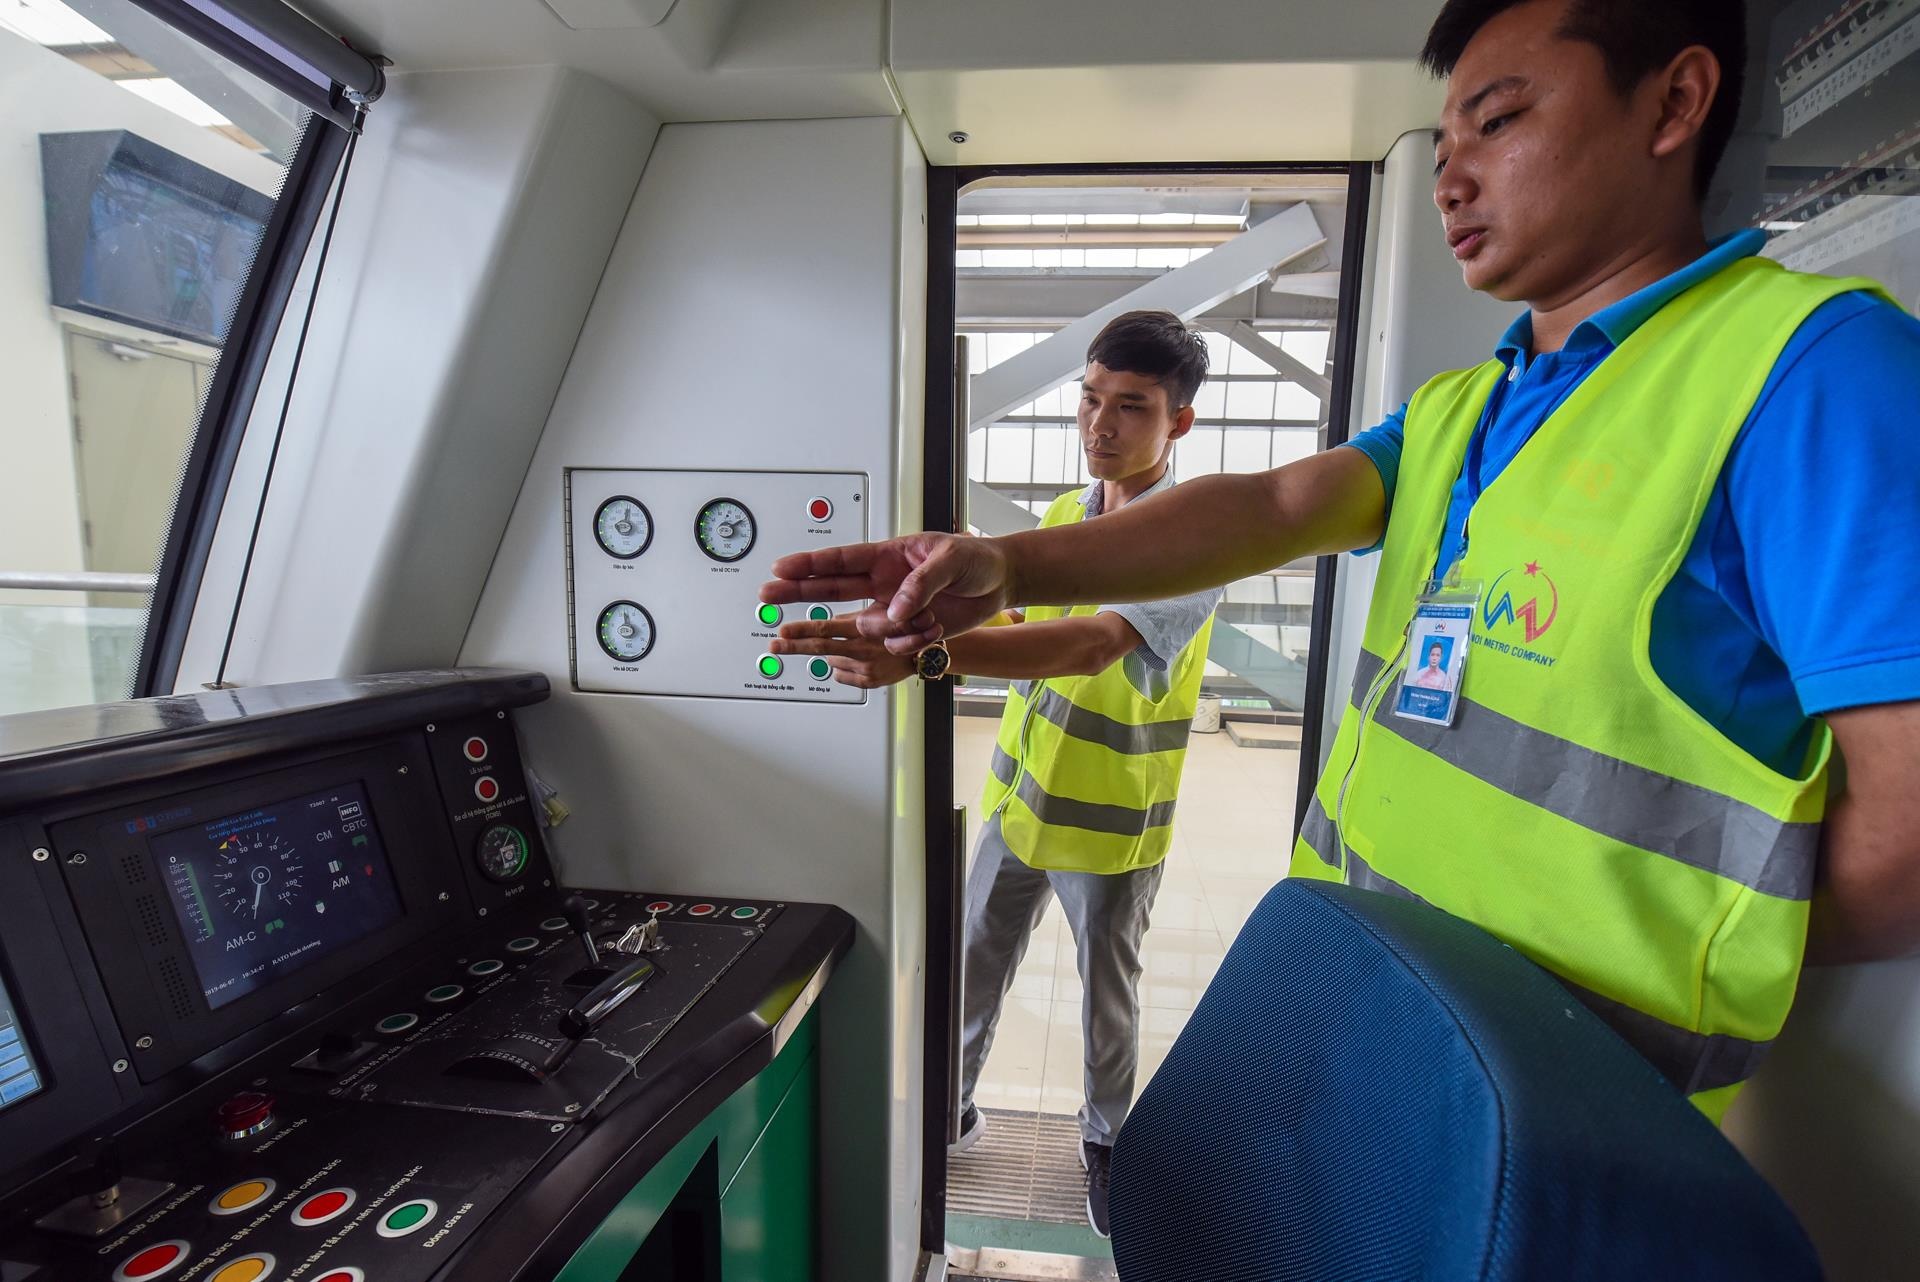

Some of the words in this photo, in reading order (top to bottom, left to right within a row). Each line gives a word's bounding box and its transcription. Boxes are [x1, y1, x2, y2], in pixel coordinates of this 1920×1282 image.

[1471, 634, 1482, 644] NOI
[1484, 638, 1510, 654] METRO
[1511, 646, 1556, 667] COMPANY
[341, 807, 358, 816] INFO
[342, 819, 368, 833] CBTC
[316, 829, 332, 841] CM
[223, 872, 232, 880] 30
[286, 879, 298, 887] 100
[332, 875, 350, 890] A/M
[278, 891, 290, 900] 110
[226, 931, 256, 952] AM-C
[230, 1227, 252, 1241] Bật
[249, 1213, 272, 1228] máy
[269, 1200, 288, 1213] nén
[283, 1189, 301, 1201] khí
[322, 1158, 342, 1171] bức
[321, 1234, 341, 1250] Tắt
[338, 1221, 359, 1237] máy
[357, 1207, 374, 1222] nén
[369, 1195, 385, 1209] khí
[383, 1177, 411, 1197] cưỡng
[405, 1164, 423, 1178] bức
[423, 1228, 449, 1248] Đóng
[444, 1214, 461, 1228] cửa
[456, 1201, 475, 1216] trái
[98, 1235, 129, 1254] Chọn
[209, 1241, 233, 1257] bức
[292, 1262, 311, 1278] rửa
[306, 1248, 326, 1264] tàu
